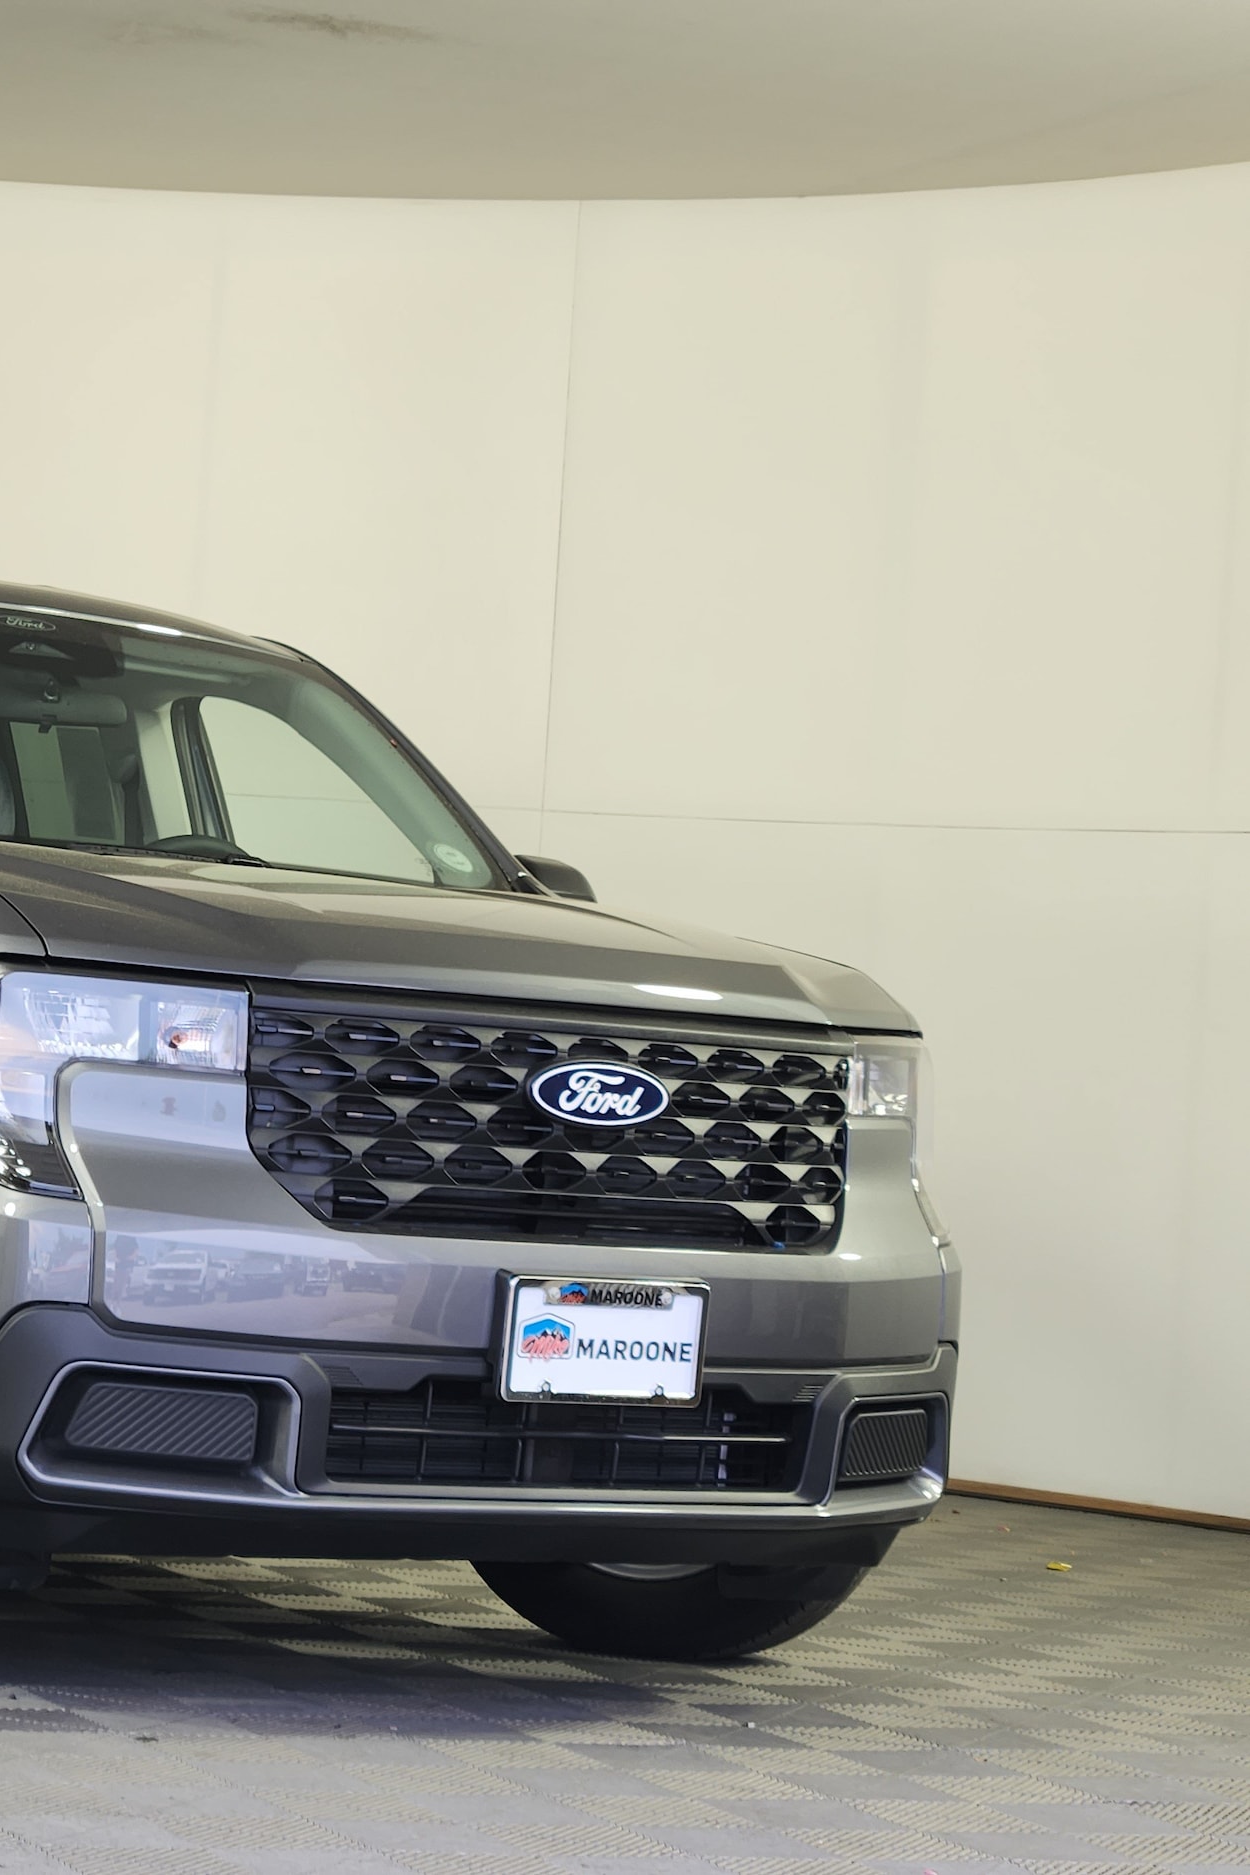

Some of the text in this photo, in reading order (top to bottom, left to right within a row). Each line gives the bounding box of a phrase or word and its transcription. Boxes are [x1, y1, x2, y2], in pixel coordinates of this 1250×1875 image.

[6, 615, 45, 630] Ford
[558, 1071, 645, 1116] Ford
[590, 1289, 664, 1306] MAROONE
[577, 1338, 693, 1363] MAROONE
